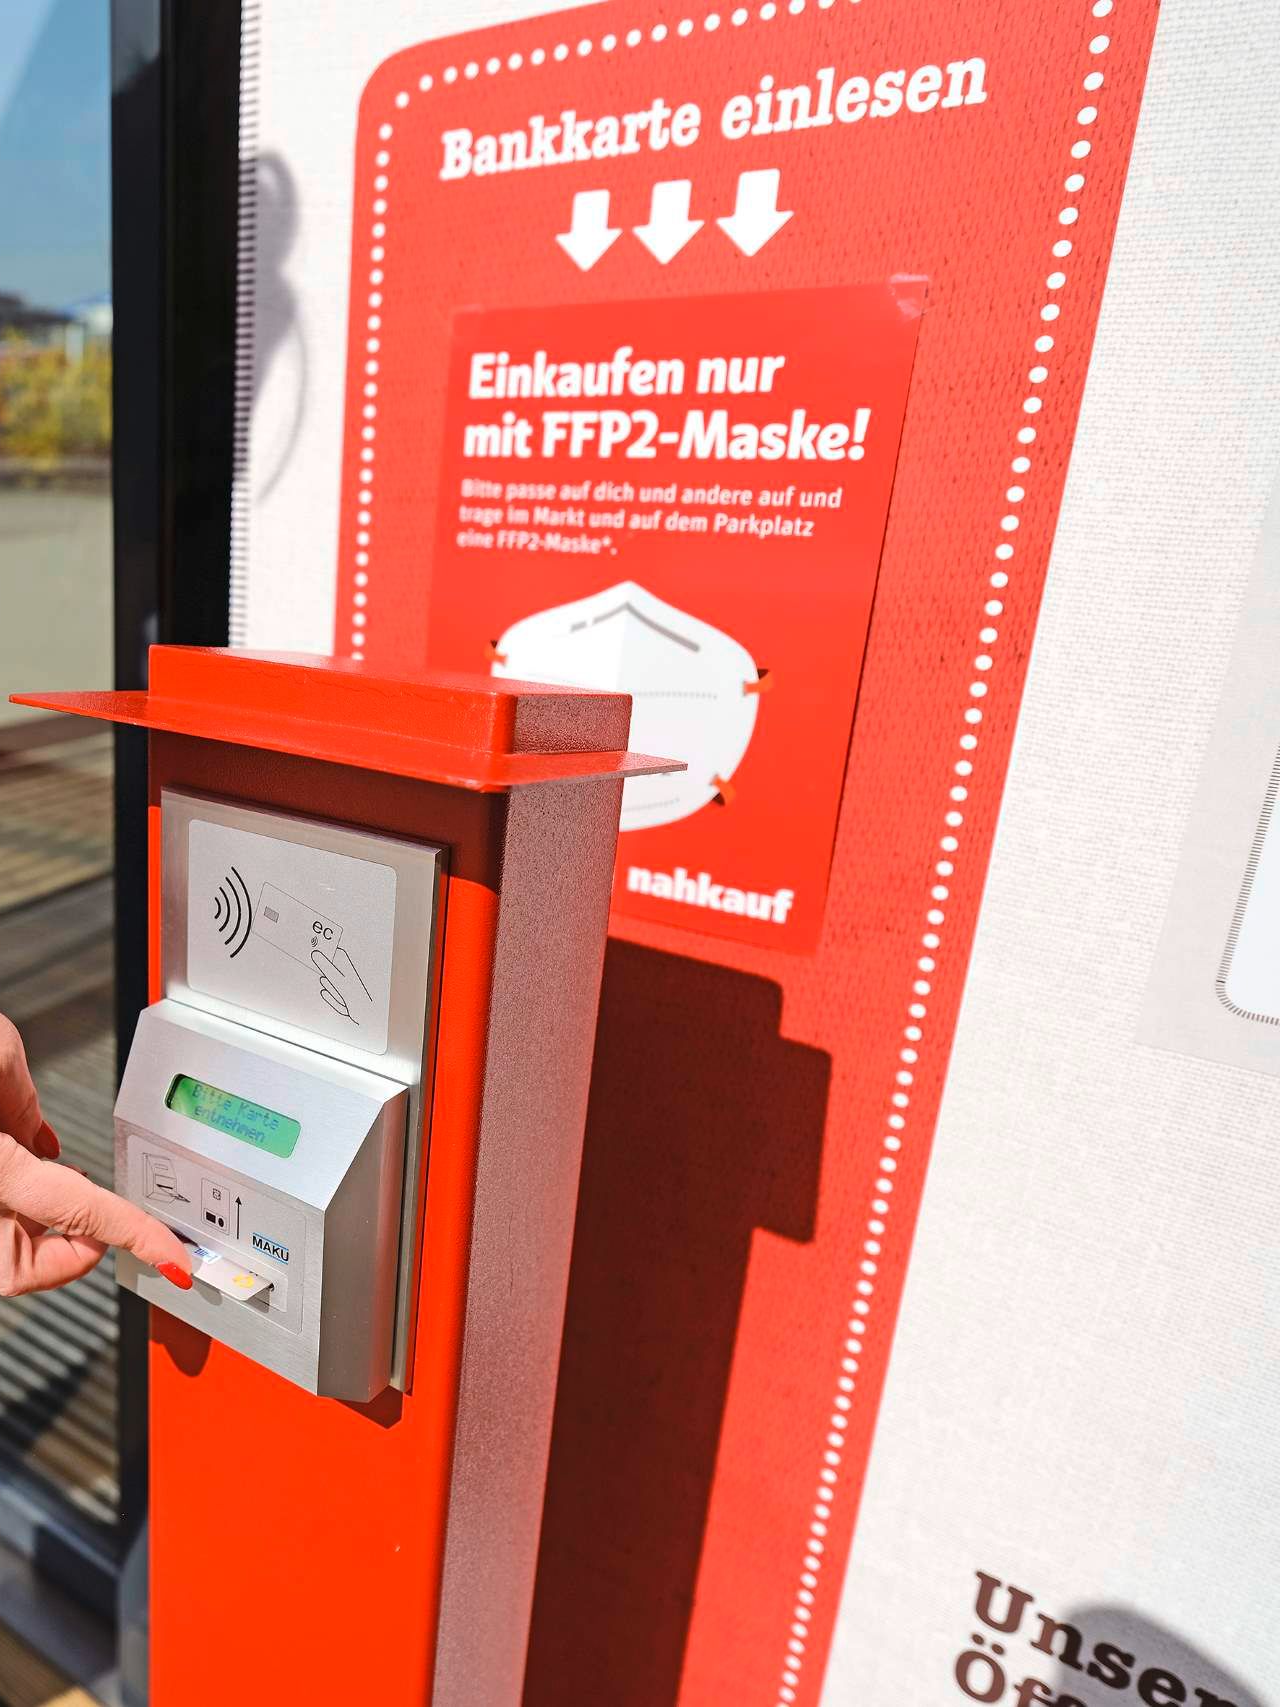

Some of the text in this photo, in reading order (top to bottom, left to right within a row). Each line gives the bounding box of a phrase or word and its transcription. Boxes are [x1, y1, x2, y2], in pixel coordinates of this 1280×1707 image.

[439, 57, 987, 180] Bankkarte einlesen
[468, 345, 786, 400] Einkaufen nur
[463, 407, 871, 461] mit FFP2-Maske!
[461, 478, 843, 508] Bitte passe auf dich und andere auf und
[456, 528, 494, 548] eine
[458, 505, 815, 539] trage im Markt und auf dem Parkplatz
[627, 866, 794, 923] nahkauf
[312, 920, 334, 941] ec
[252, 1235, 290, 1262] MAKU
